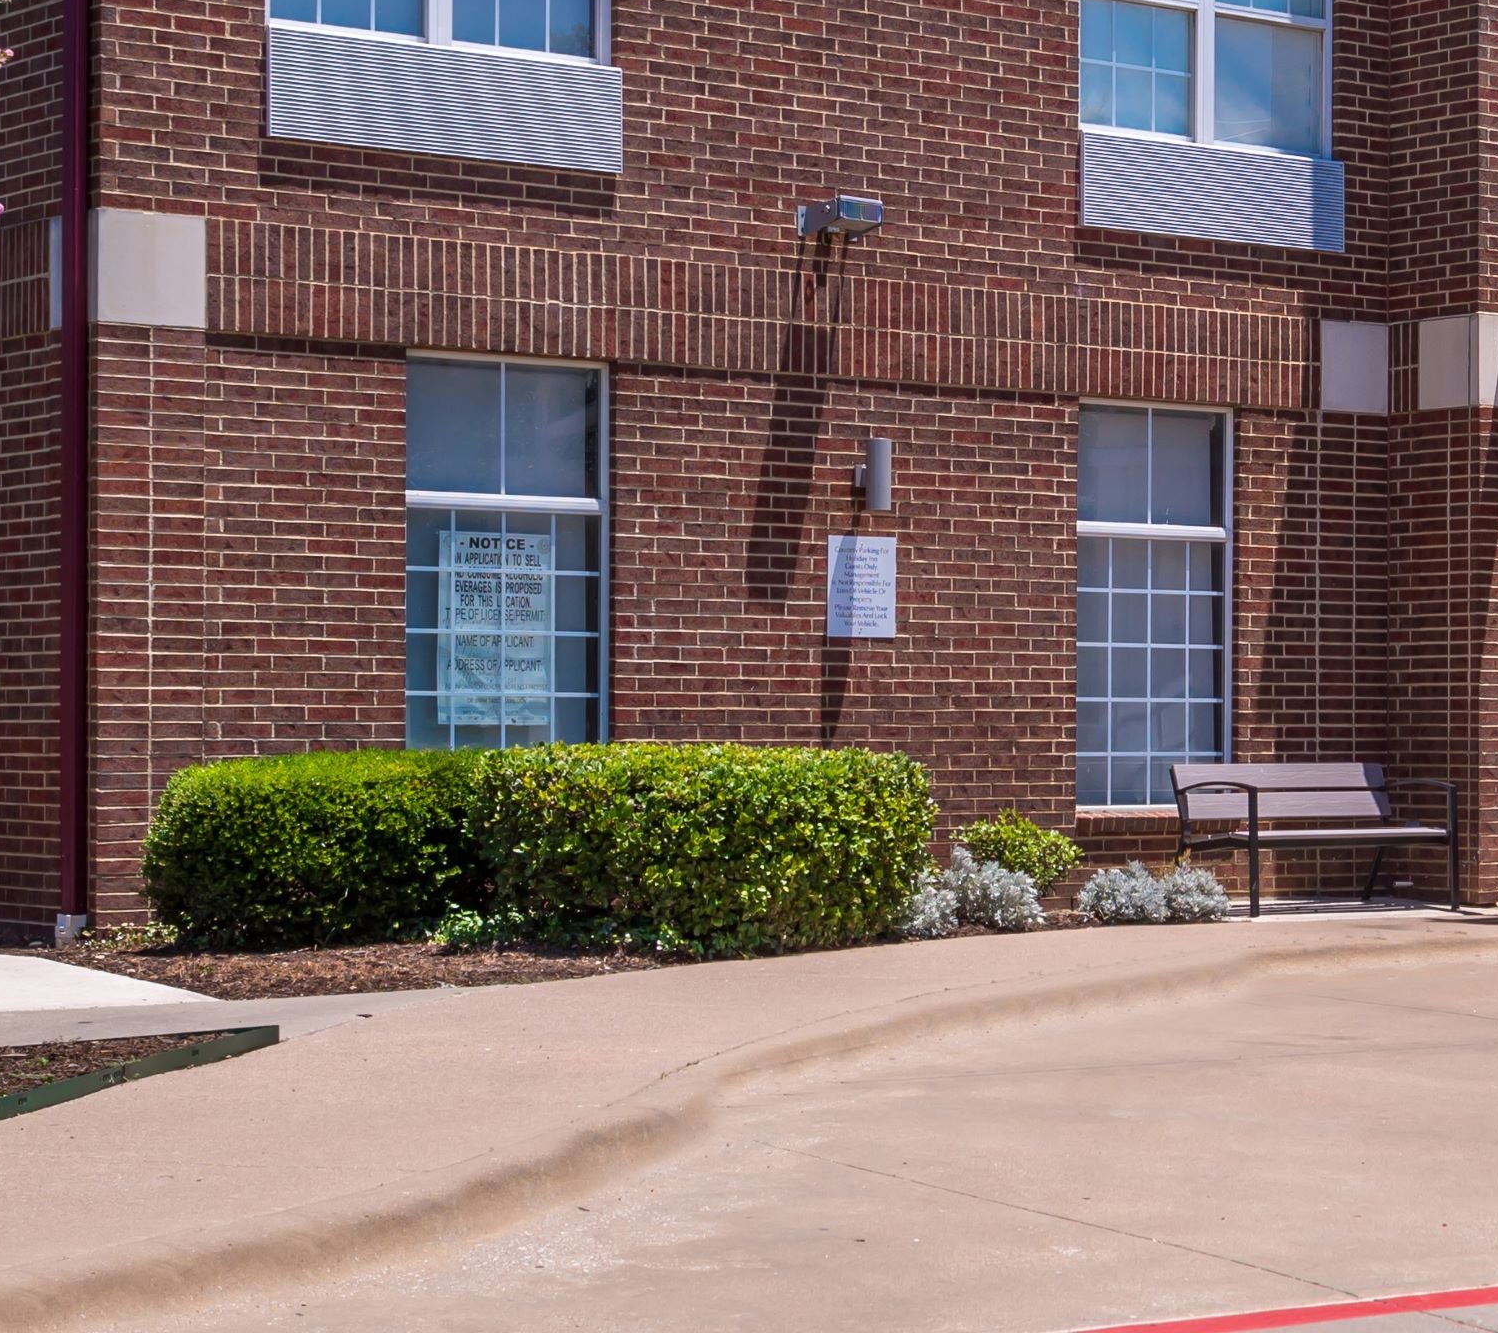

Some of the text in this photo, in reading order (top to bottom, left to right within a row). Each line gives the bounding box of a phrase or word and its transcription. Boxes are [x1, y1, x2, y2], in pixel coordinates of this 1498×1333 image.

[469, 537, 526, 550] NOTCE
[512, 554, 522, 566] TO
[525, 554, 542, 567] SELL
[454, 580, 543, 595] EVERAGES IS PROPOSED
[460, 594, 532, 609] FOR THIS LCATION.
[445, 607, 466, 620] TPE
[468, 608, 480, 620] OF
[455, 634, 535, 649] NAME OF APLICANT:
[486, 659, 497, 671] OF
